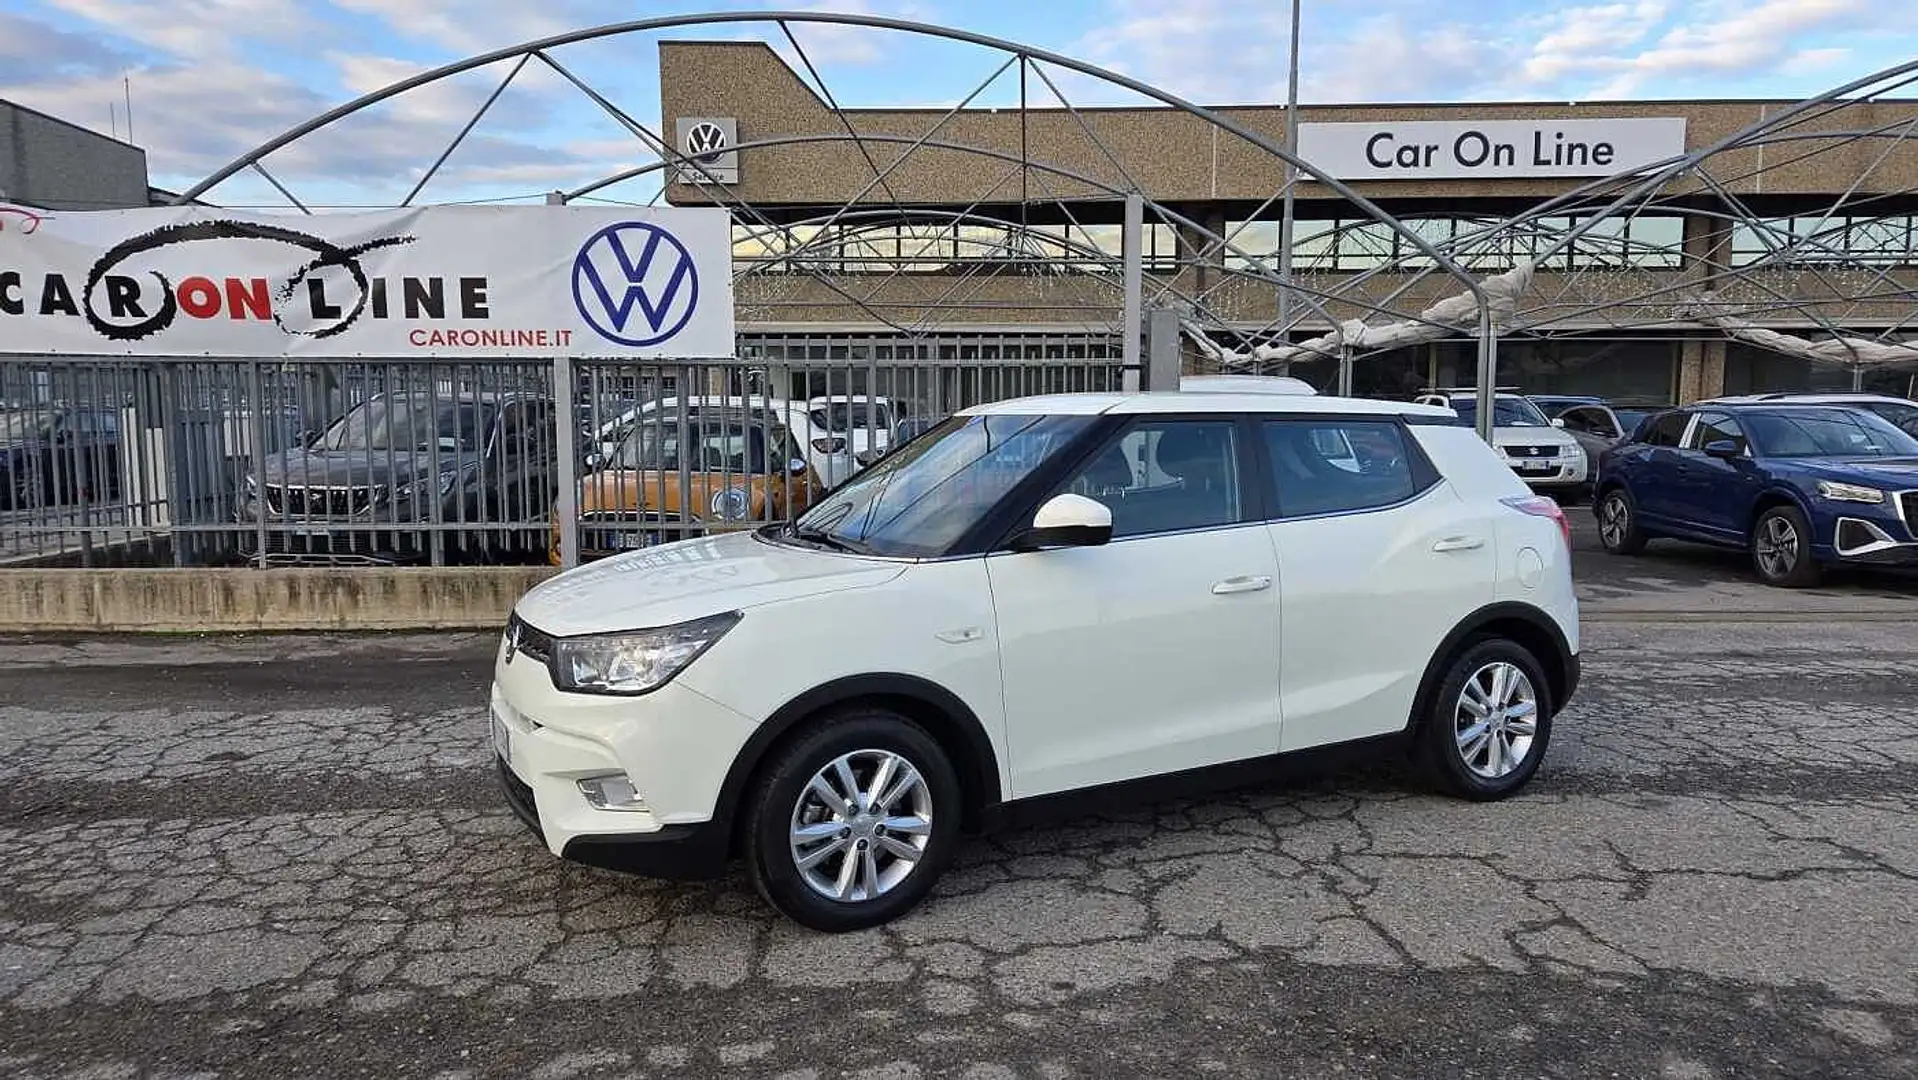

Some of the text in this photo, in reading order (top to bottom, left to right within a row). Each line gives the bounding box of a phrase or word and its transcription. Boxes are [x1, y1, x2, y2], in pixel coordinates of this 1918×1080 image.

[1366, 131, 1614, 168] Car On Line
[573, 222, 698, 346] VW
[409, 329, 572, 347] CARONLINE.IT
